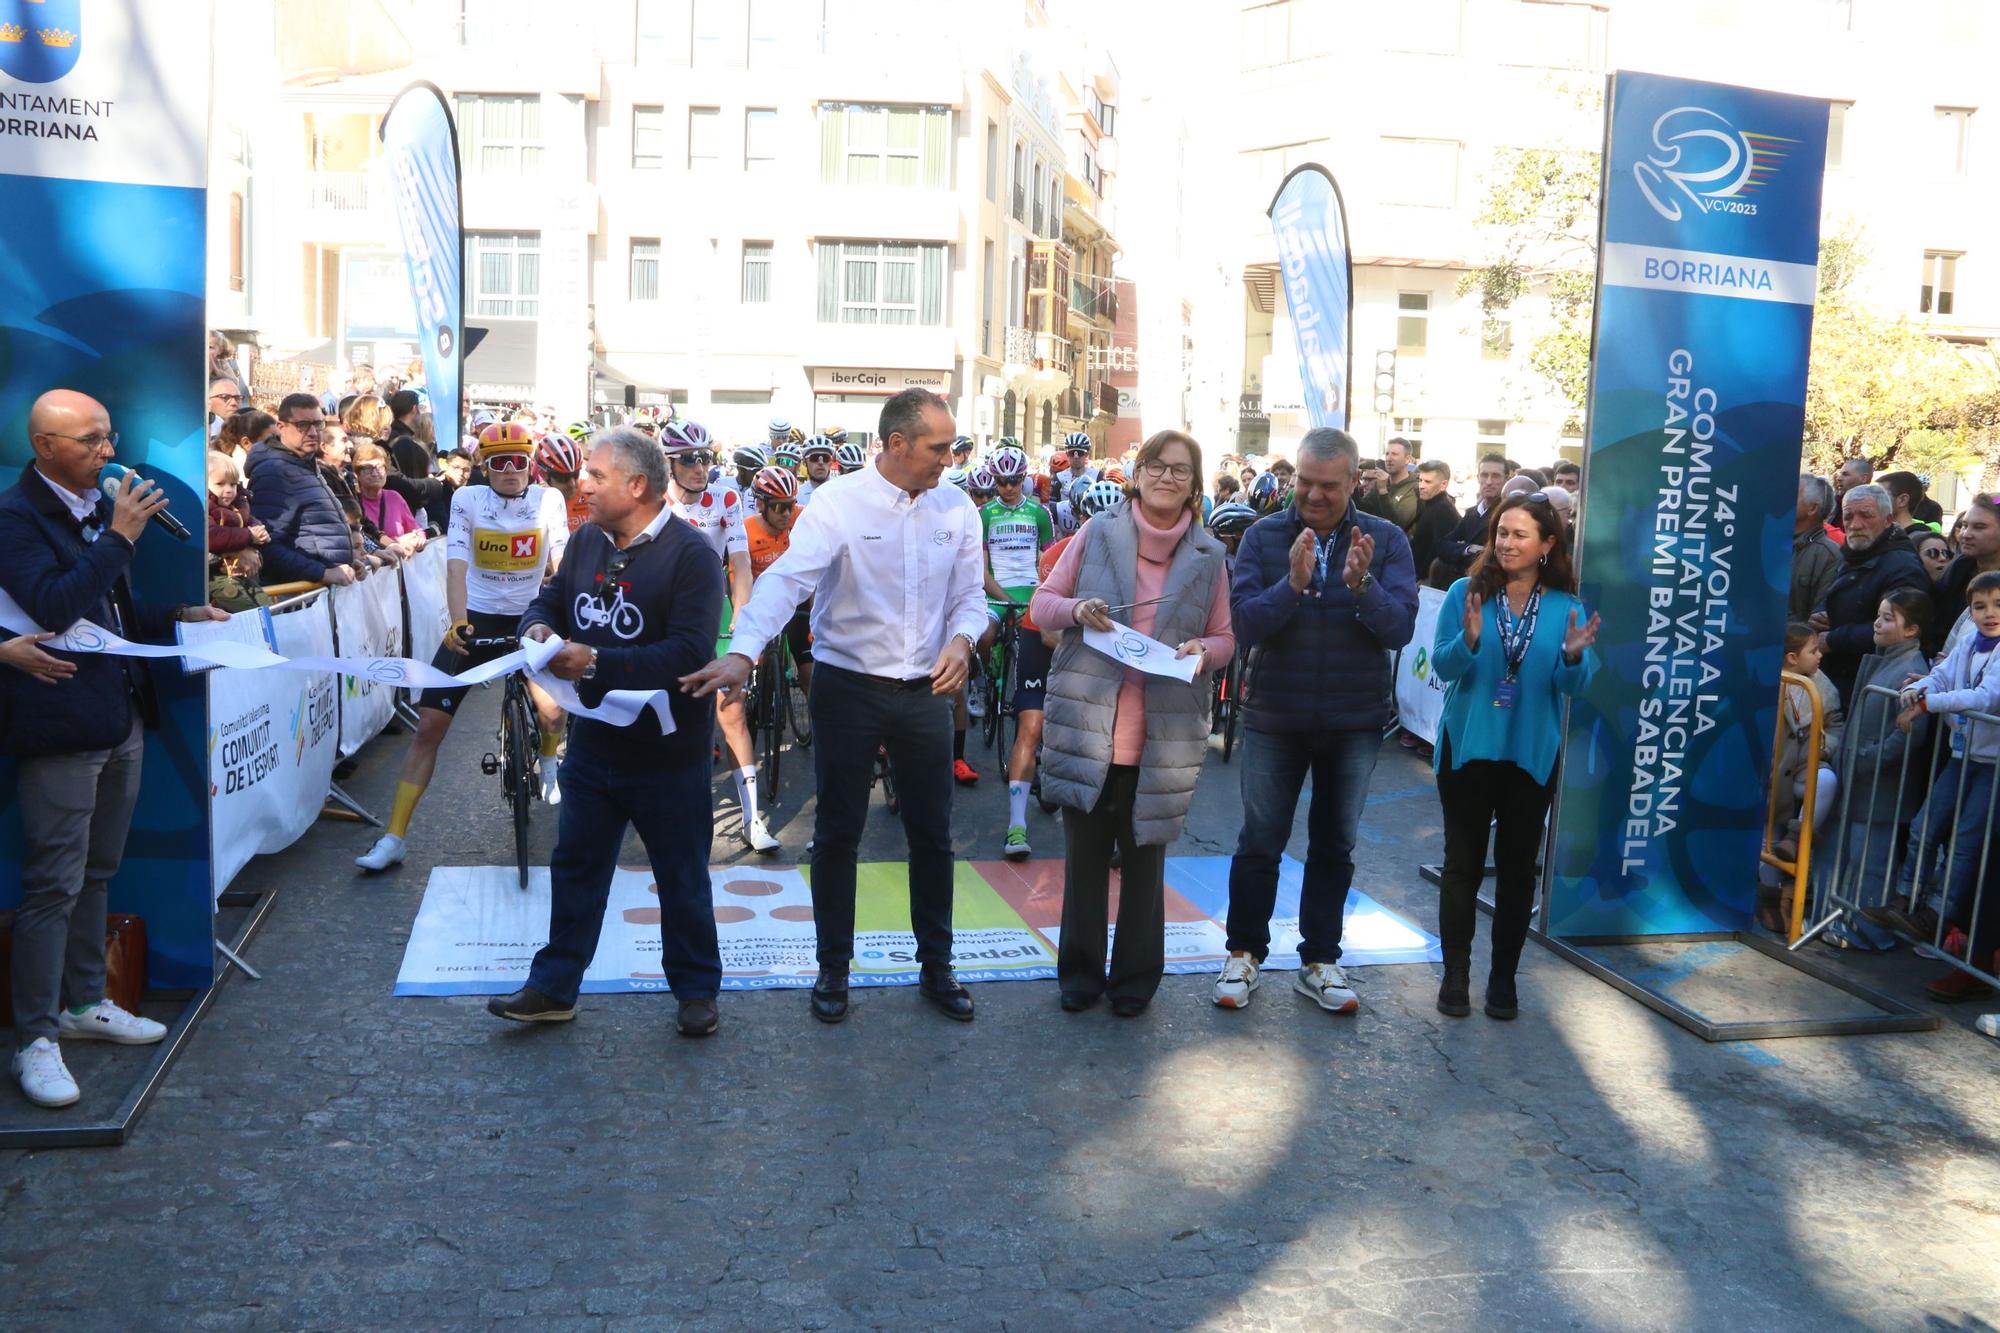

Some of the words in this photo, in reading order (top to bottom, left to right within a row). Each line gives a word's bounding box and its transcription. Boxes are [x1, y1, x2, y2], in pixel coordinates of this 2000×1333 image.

[1704, 198, 1758, 216] VCV2023
[1644, 257, 1773, 291] BORRIANA
[831, 371, 887, 387] iberCaja
[1661, 348, 1693, 455] GRAN
[1678, 387, 1718, 604] COMUNITAT
[1652, 465, 1684, 576] PREMI
[479, 540, 508, 553] Uno
[1701, 544, 1733, 655] VOLTA
[1642, 586, 1674, 689] BANC
[1697, 661, 1721, 686] A
[1653, 608, 1700, 837] VALENCIANA
[1693, 695, 1719, 736] LA
[226, 765, 246, 795] DE
[1621, 698, 1663, 877] SABADELL
[888, 945, 1041, 962] Sadell
[1001, 969, 1056, 978] GRAN
